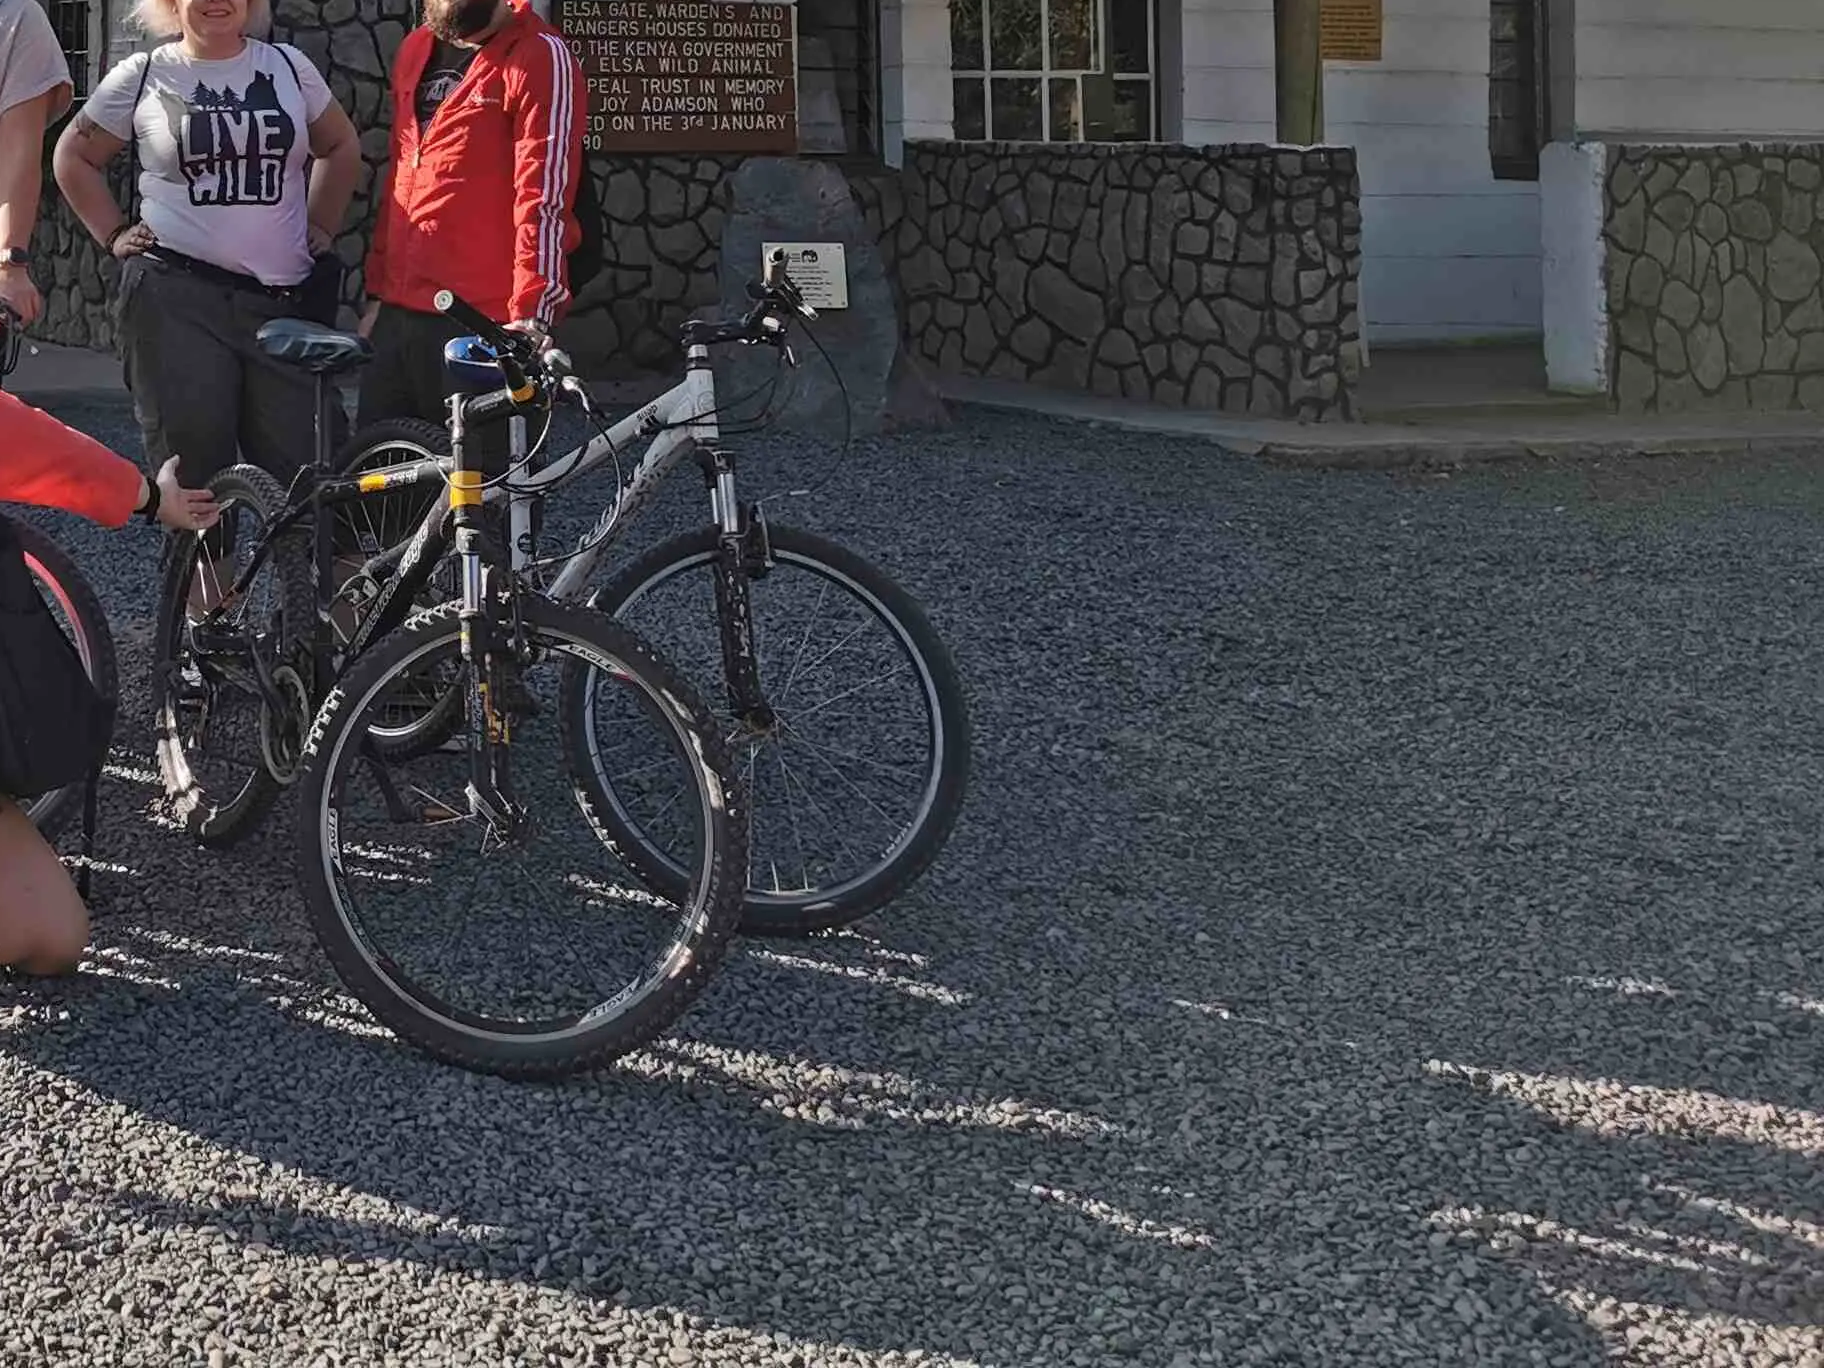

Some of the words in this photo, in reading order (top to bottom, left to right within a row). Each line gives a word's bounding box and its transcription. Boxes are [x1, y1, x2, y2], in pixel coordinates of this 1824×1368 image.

[563, 1, 602, 17] ELSA
[609, 2, 653, 19] GATE,
[749, 6, 784, 20] AND
[563, 20, 639, 35] RANGERS
[645, 22, 707, 37] HOUSES
[713, 23, 781, 38] DONATED
[588, 40, 620, 55] THE
[625, 41, 676, 57] KENYA
[682, 42, 784, 58] GOVERNMENT
[599, 58, 645, 72] ELSA
[659, 58, 699, 74] WILD
[711, 59, 774, 74] ANIMAL
[640, 79, 690, 94] TRUST
[699, 79, 715, 94] IN
[725, 80, 785, 94] MEMORY
[599, 97, 628, 112] JOY
[641, 97, 718, 112] ADAMSON
[731, 97, 765, 112] WHO
[612, 115, 635, 131] ON
[643, 116, 673, 131] THE
[681, 115, 704, 131] 3rd
[711, 115, 787, 130] JANUARY
[180, 109, 285, 162] LIVE
[185, 158, 282, 202] WILD
